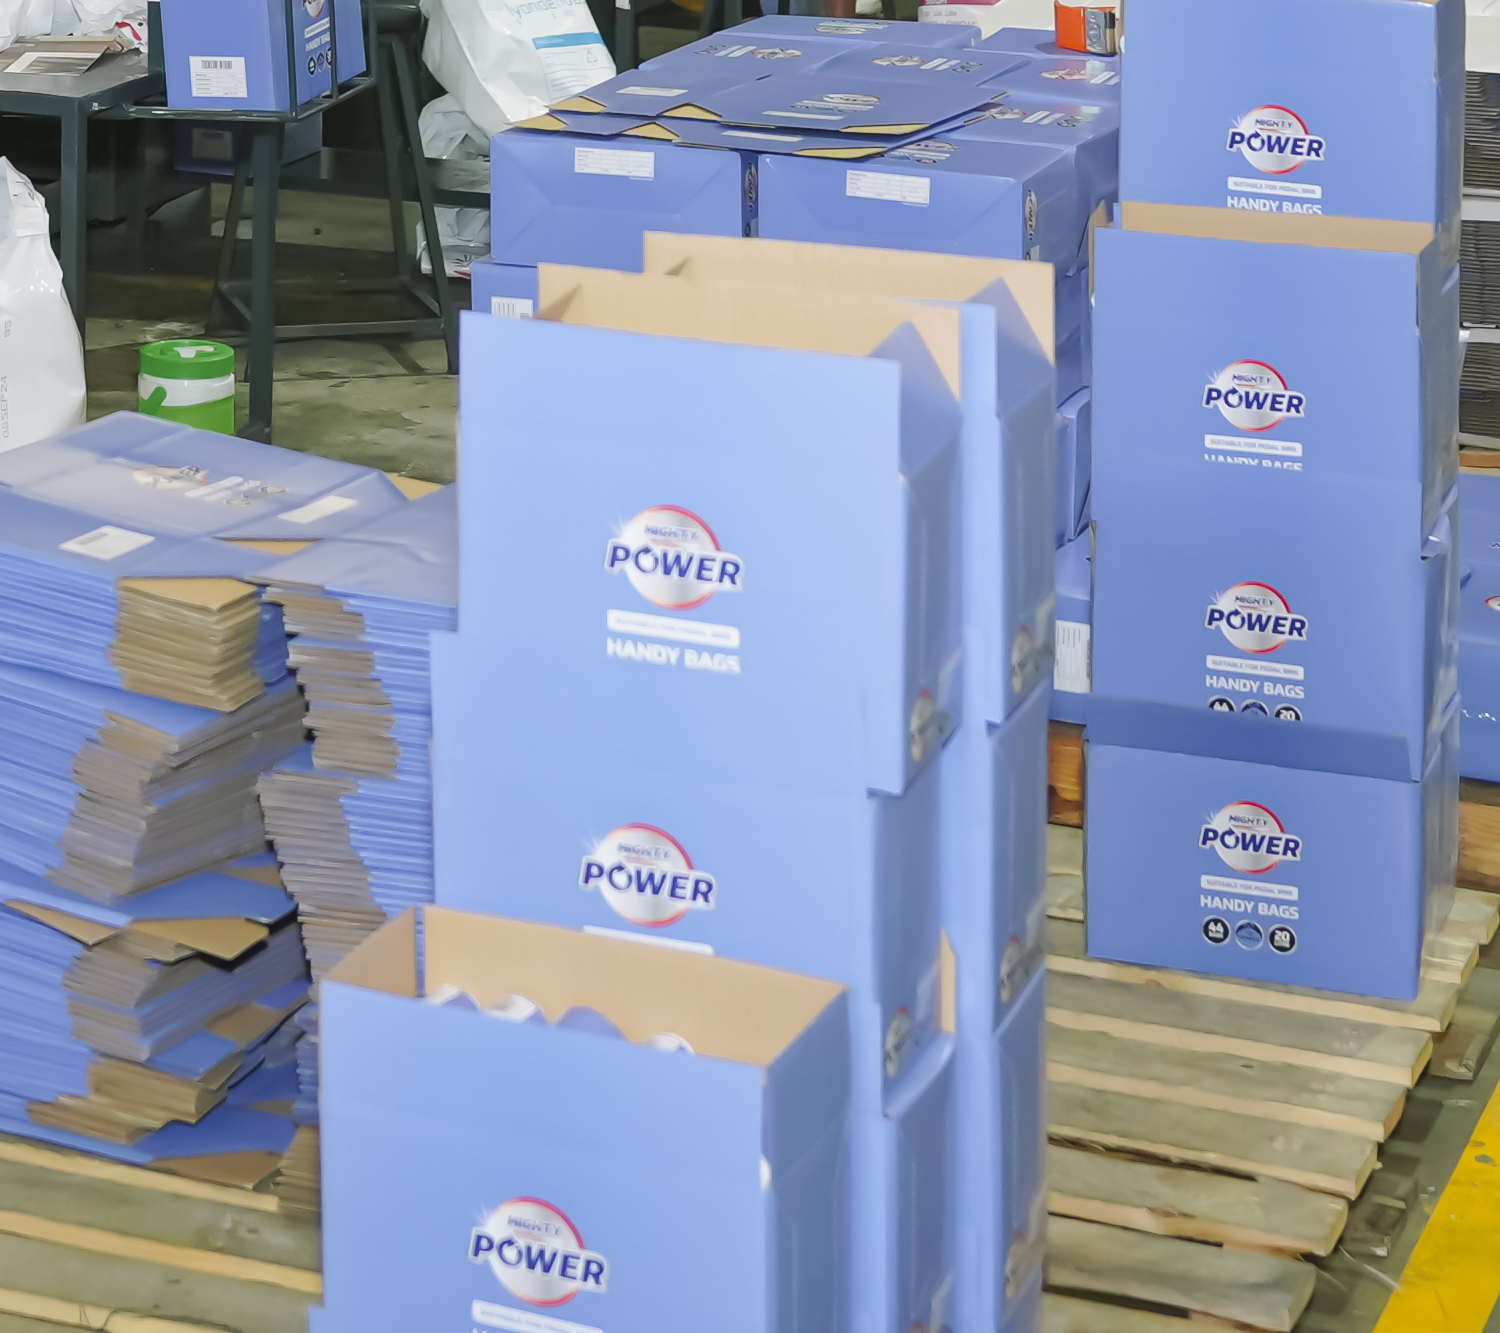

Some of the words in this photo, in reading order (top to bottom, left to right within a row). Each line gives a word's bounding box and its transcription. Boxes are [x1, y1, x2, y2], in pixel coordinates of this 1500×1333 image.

[1228, 129, 1324, 158] POWER
[1226, 195, 1280, 212] HANDY
[1282, 200, 1323, 215] BAGS
[1205, 387, 1304, 414] POWER
[609, 544, 742, 586] POWER
[1207, 608, 1306, 638] POWER
[606, 636, 681, 667] HANDY
[684, 647, 742, 675] BAGS
[1205, 675, 1260, 694] HANDY
[1264, 681, 1305, 699] BAGS
[1201, 827, 1300, 858] POWER
[584, 861, 714, 904] POWER
[1200, 894, 1254, 914] HANDY
[1258, 901, 1300, 920] BAGS
[1274, 930, 1291, 941] 20
[473, 1234, 605, 1286] POWER
